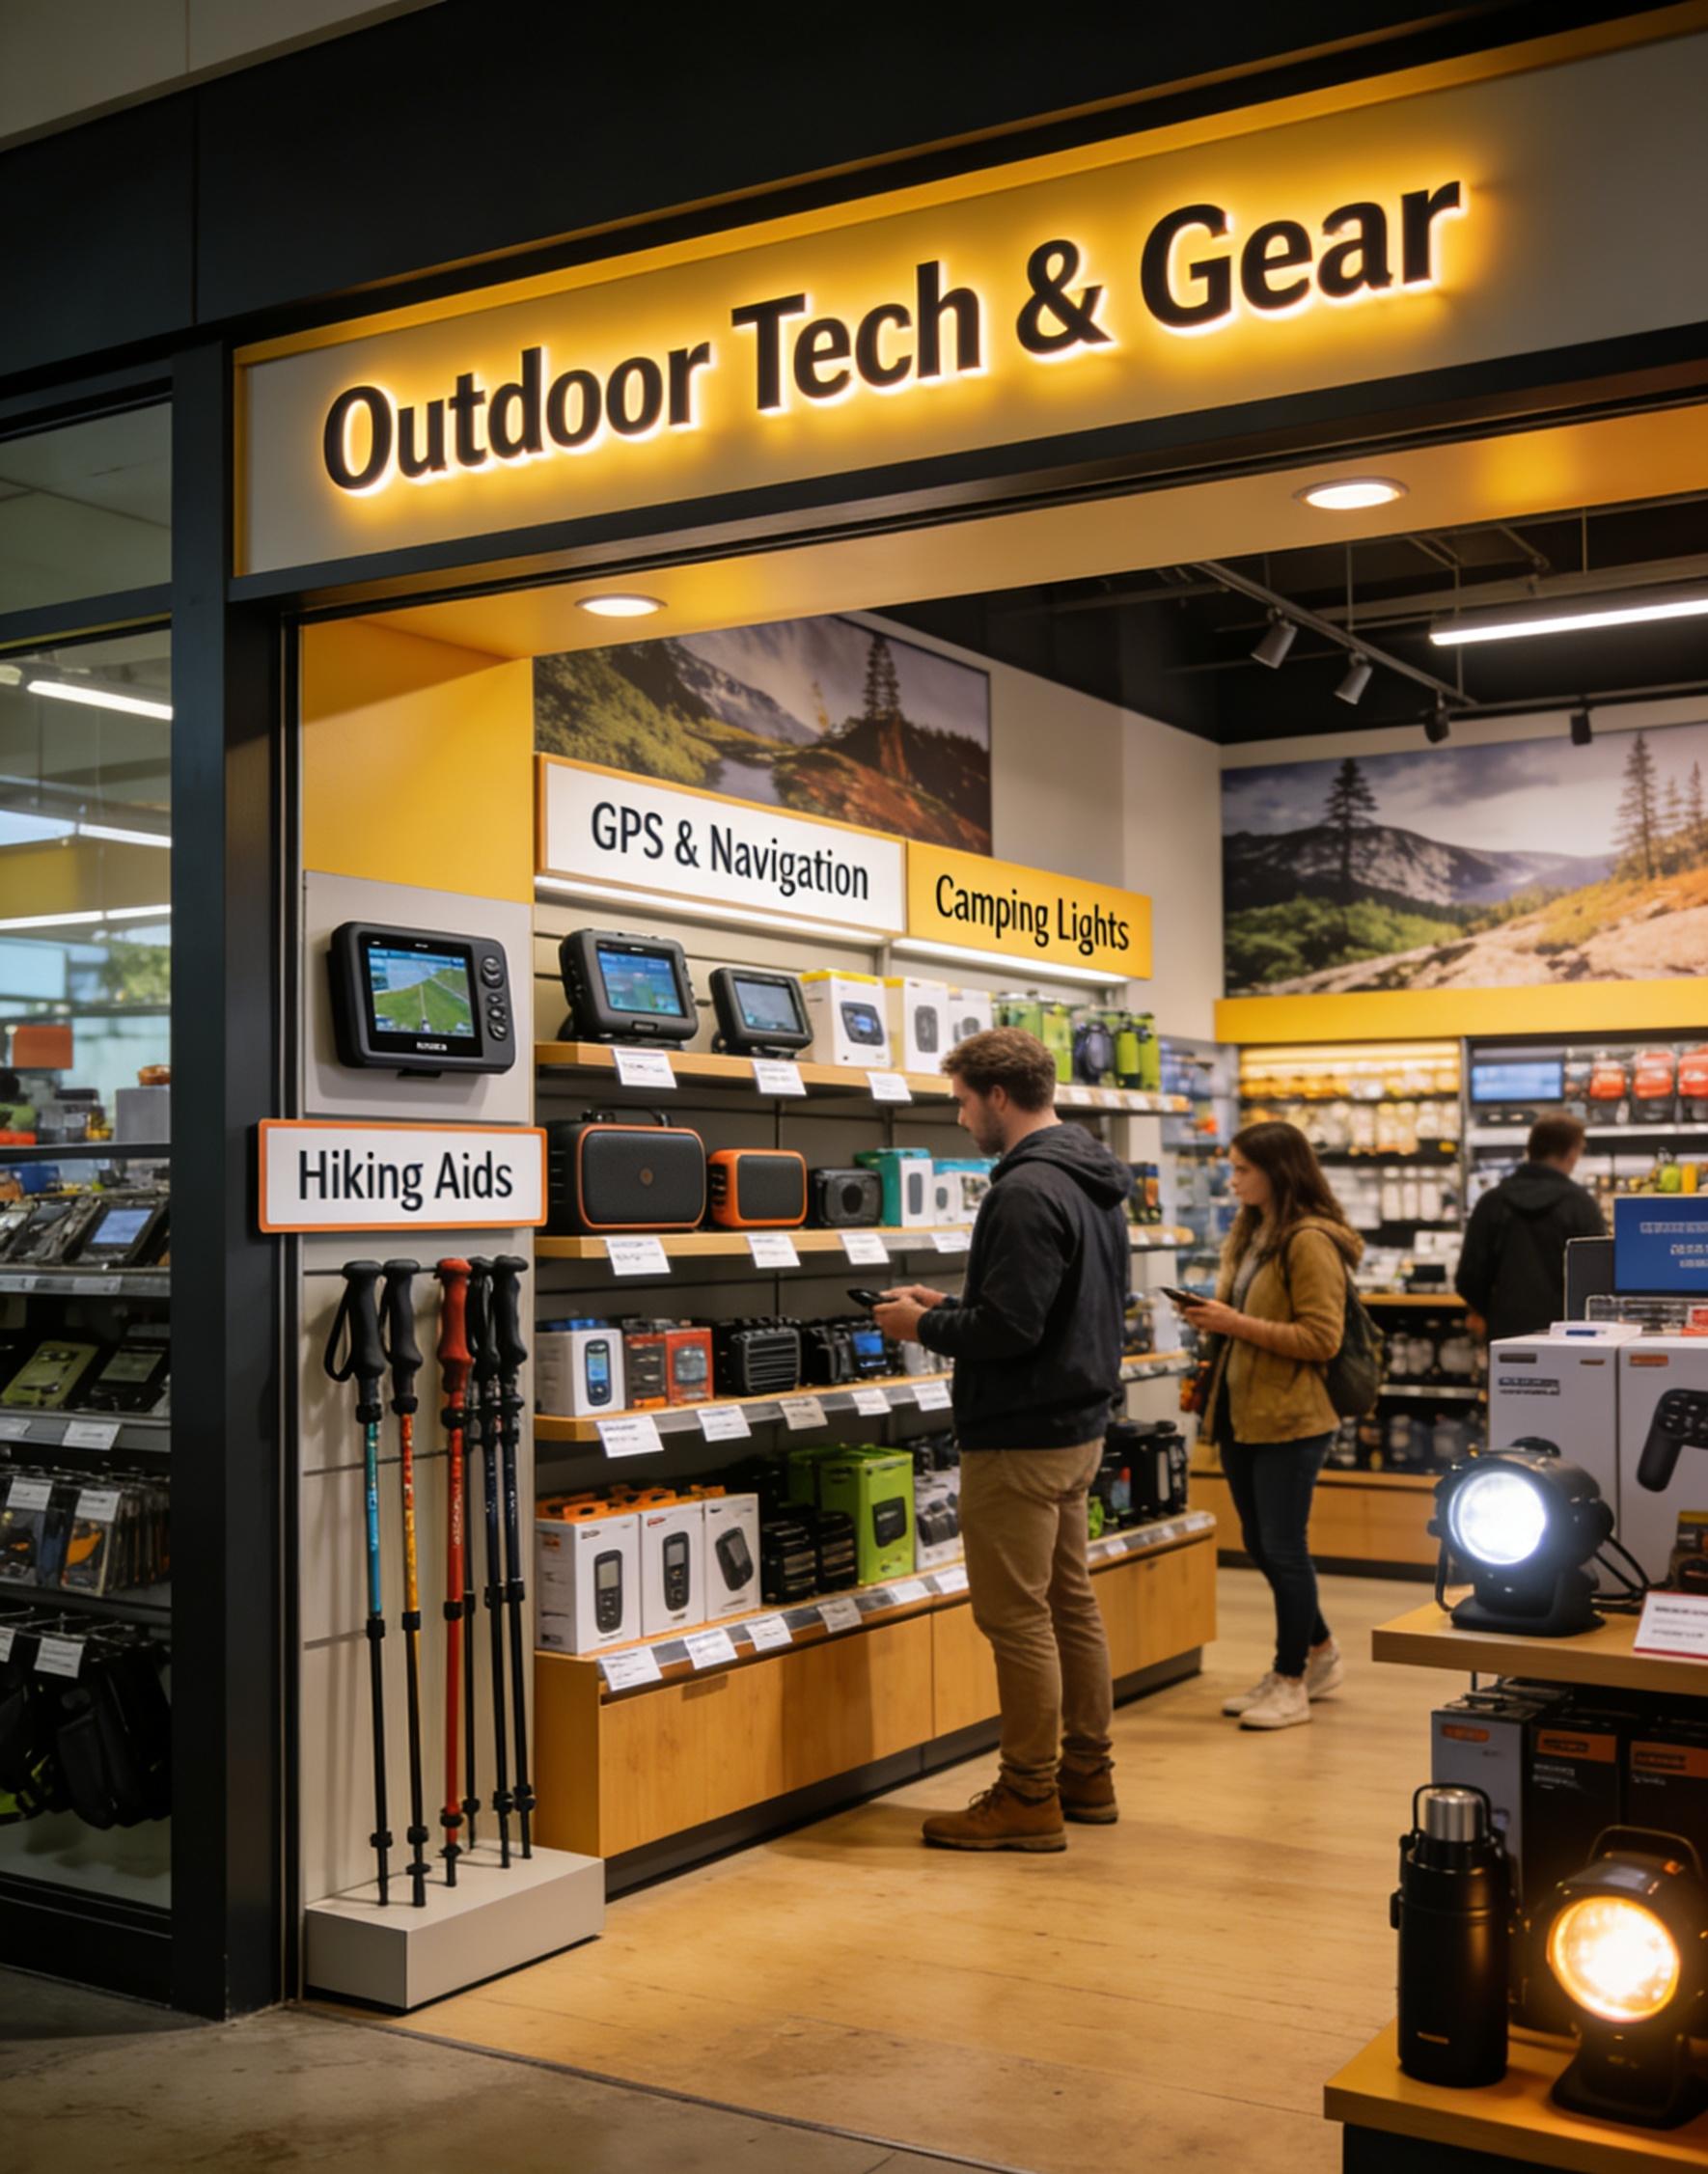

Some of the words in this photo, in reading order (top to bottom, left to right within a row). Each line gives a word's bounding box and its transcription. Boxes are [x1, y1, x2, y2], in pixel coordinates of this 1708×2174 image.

[323, 342, 711, 492] Outdoor
[731, 261, 982, 412] Tech
[1016, 239, 1113, 357] &
[1141, 180, 1460, 329] Gear
[591, 802, 664, 859] GPS
[675, 818, 701, 868] &
[711, 824, 869, 900] Navigation
[936, 874, 1048, 948] Camping
[1058, 899, 1130, 955] Lights
[299, 1148, 424, 1212] Hiking
[434, 1150, 513, 1200] Aids
